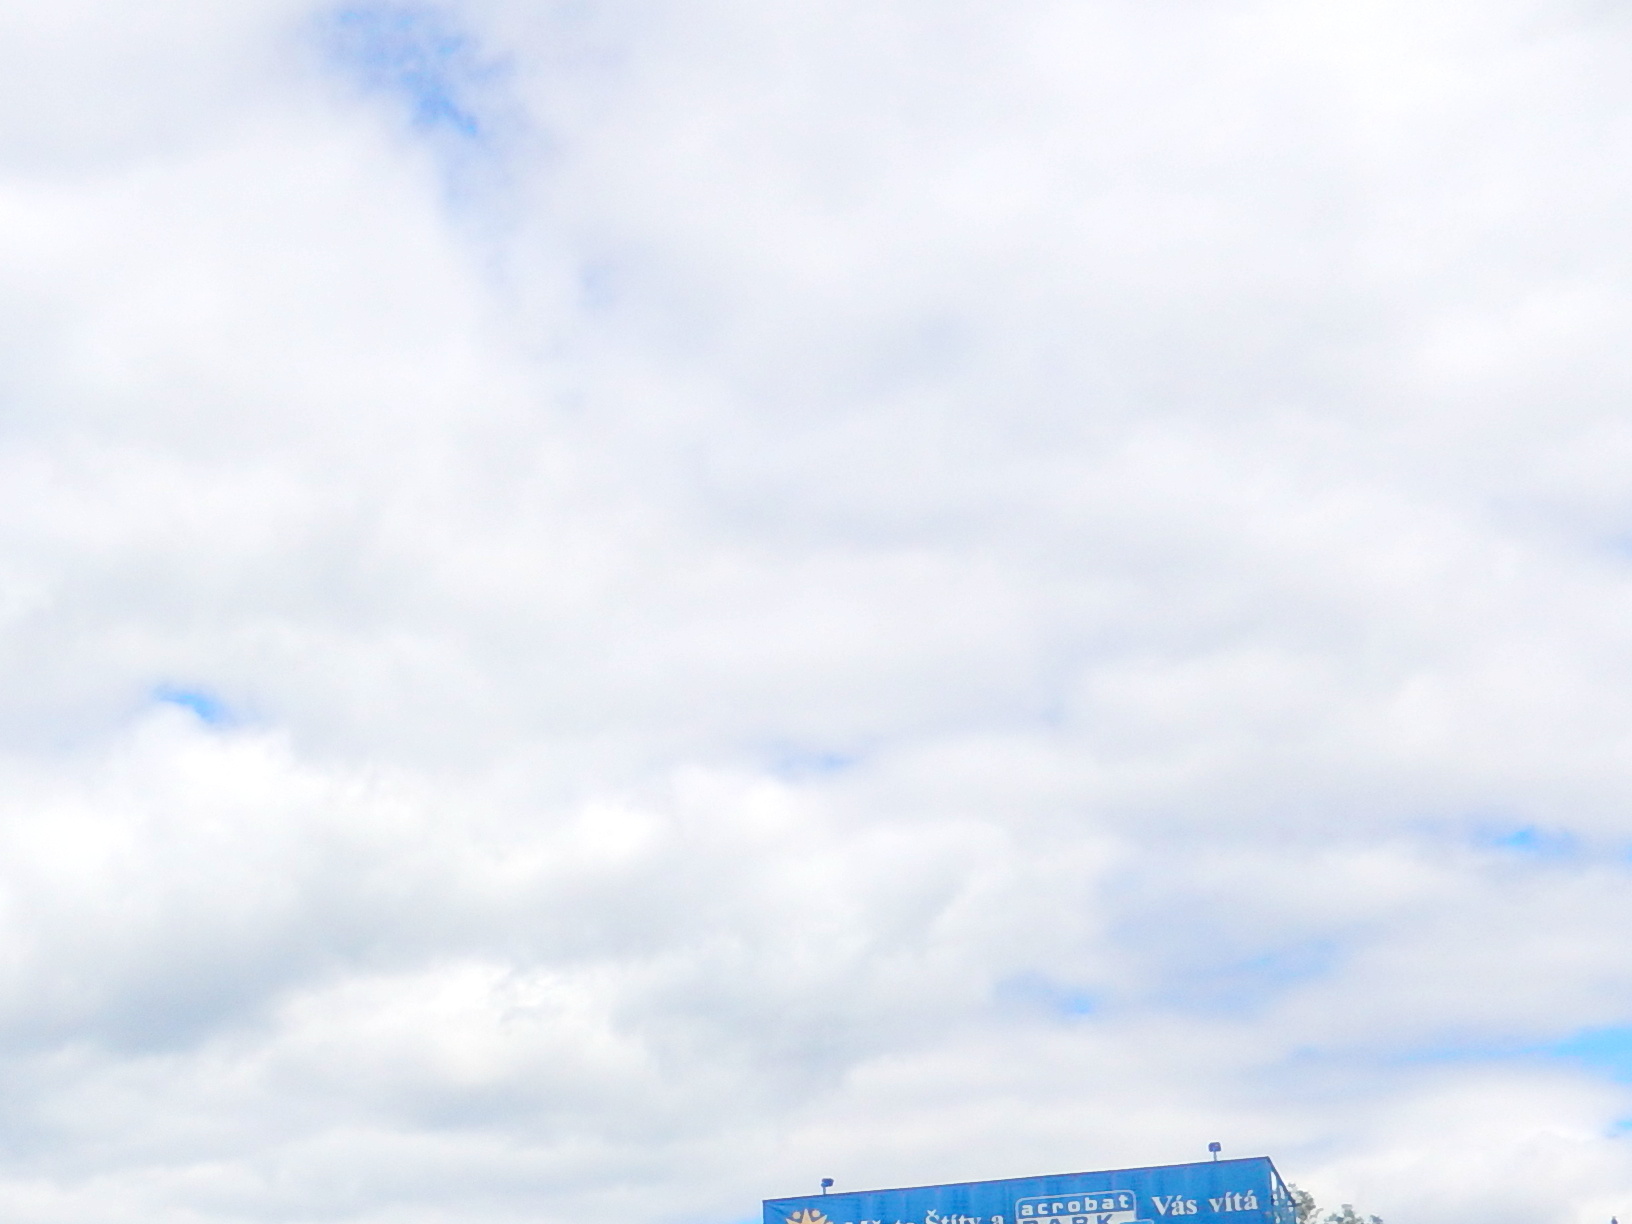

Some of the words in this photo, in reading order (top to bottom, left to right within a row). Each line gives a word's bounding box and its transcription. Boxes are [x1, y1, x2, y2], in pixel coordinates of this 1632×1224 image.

[1021, 1194, 1129, 1215] acrobat
[1152, 1195, 1198, 1216] Vás
[1209, 1190, 1258, 1212] vítá
